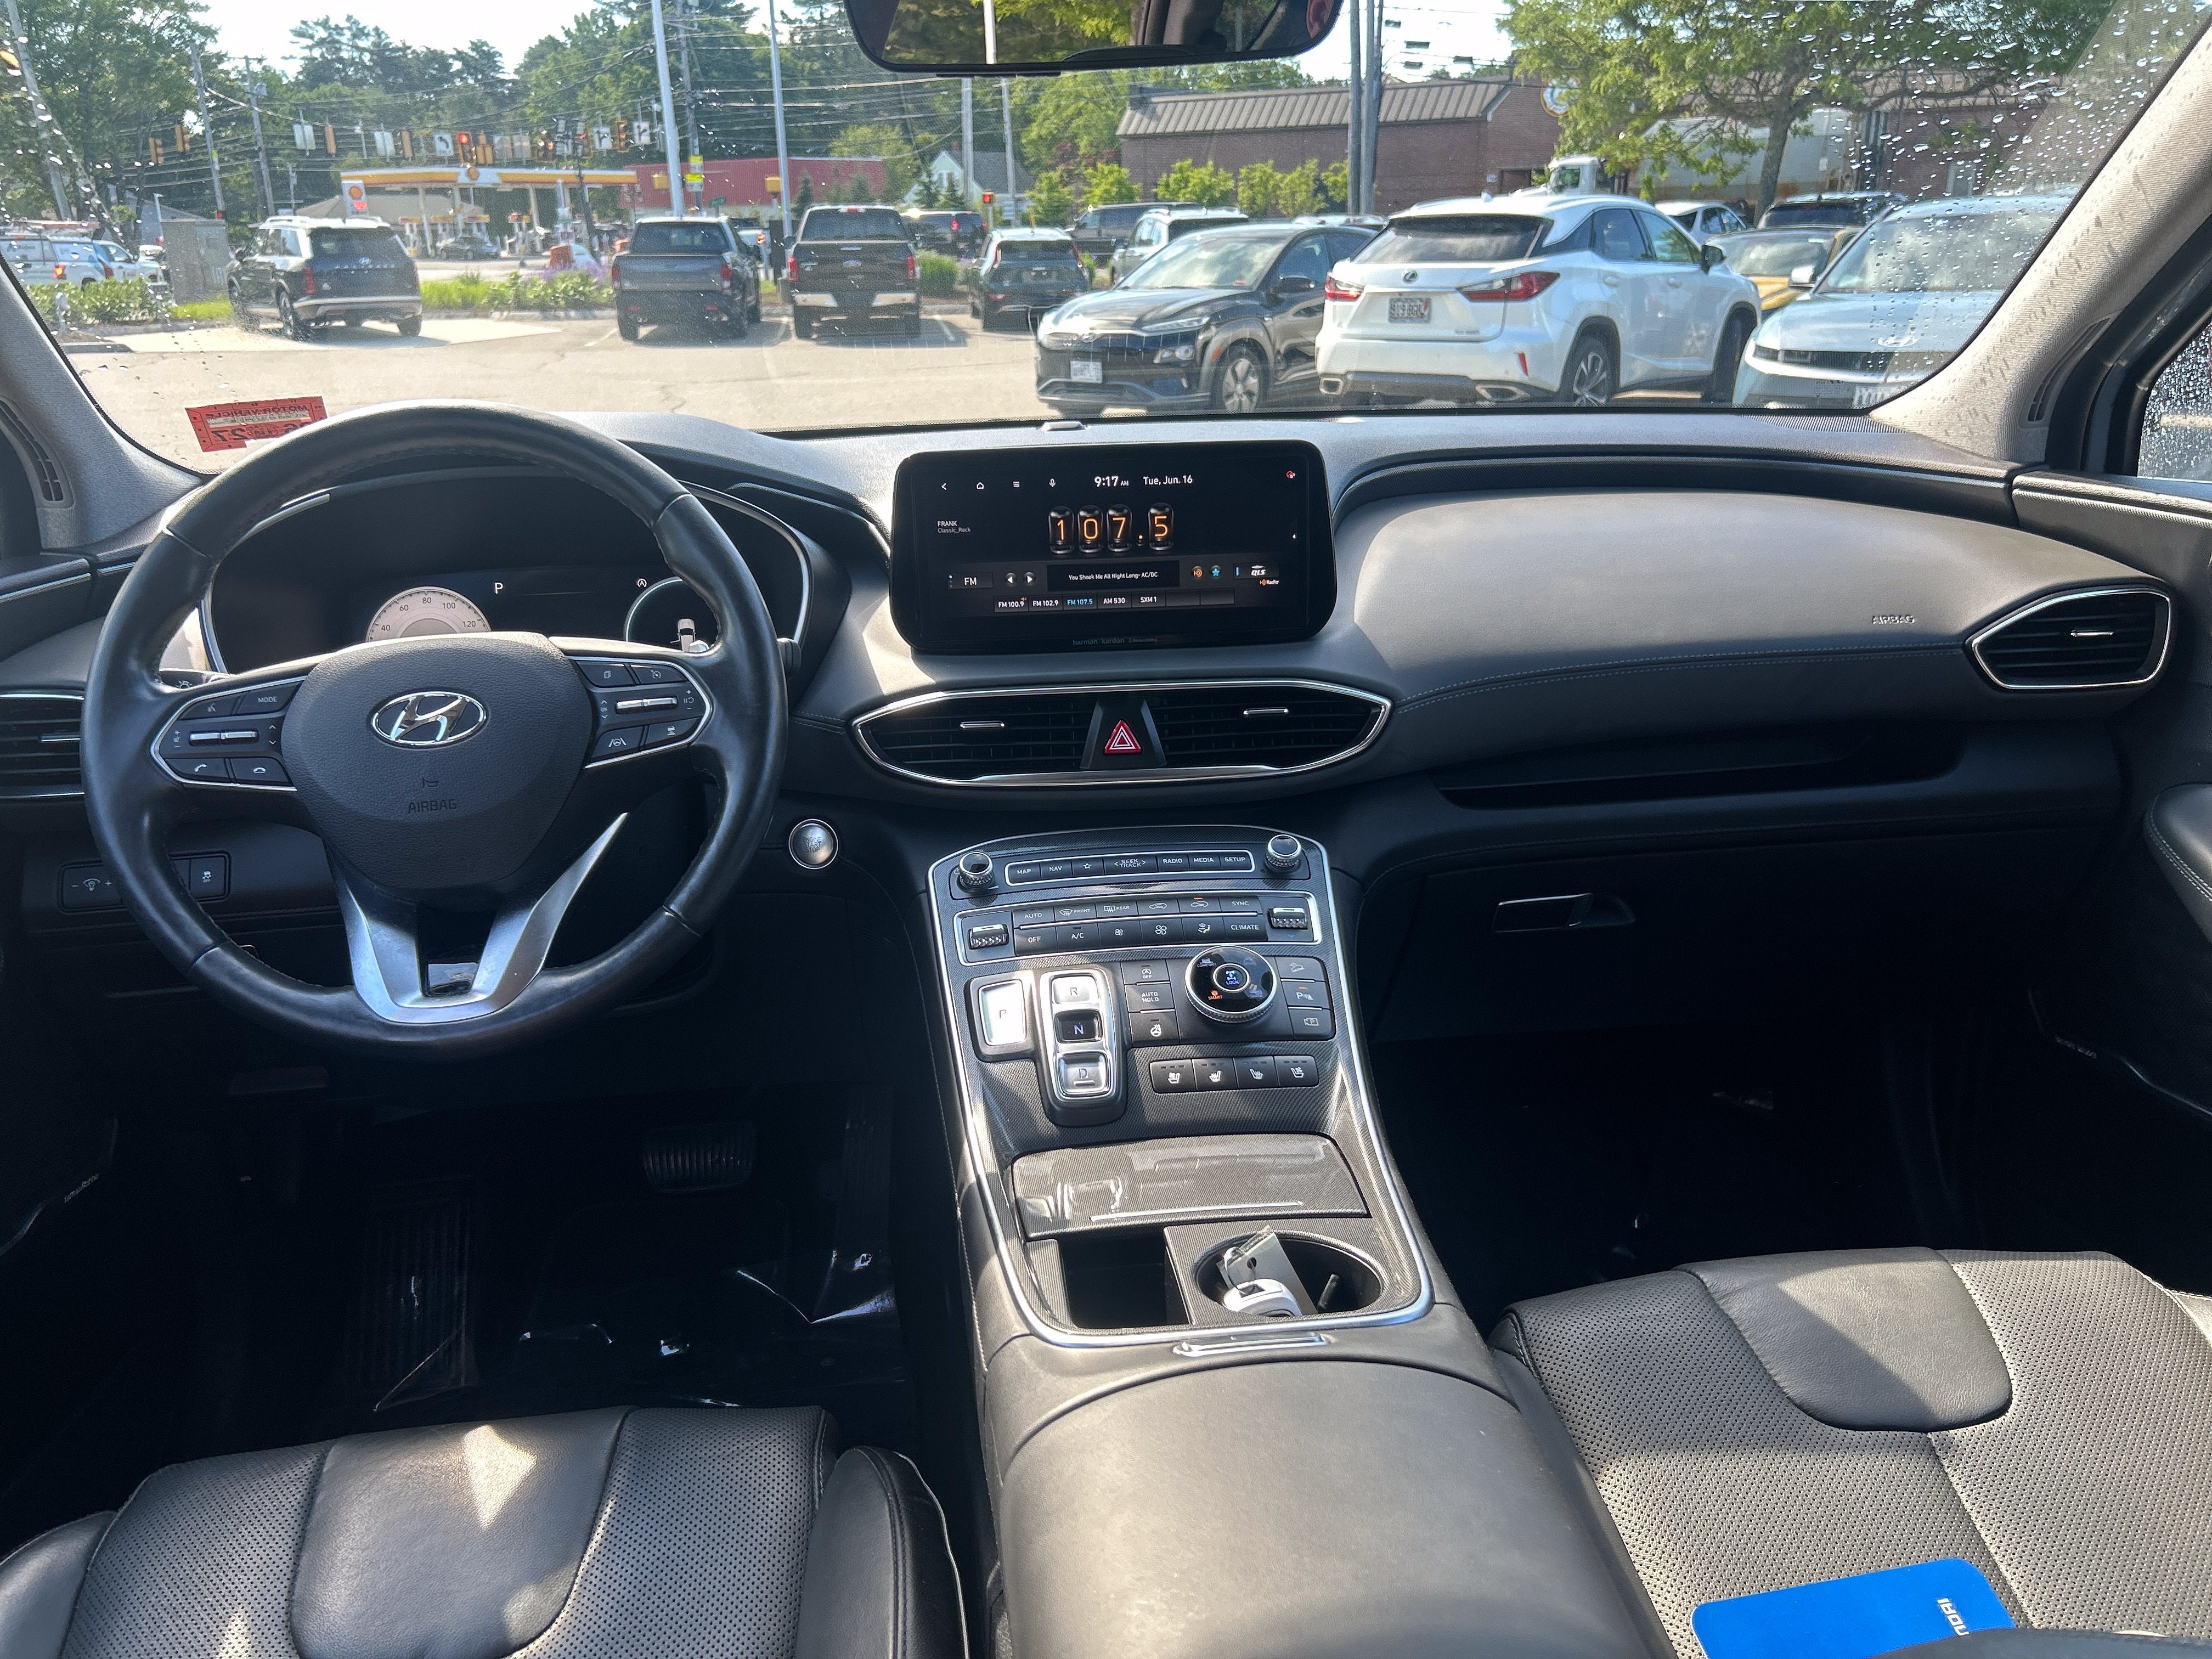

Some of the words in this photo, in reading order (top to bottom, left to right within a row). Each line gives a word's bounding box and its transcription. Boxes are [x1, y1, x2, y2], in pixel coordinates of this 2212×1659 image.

[1094, 476, 1119, 487] 9:17
[1143, 476, 1161, 486] Tue,
[1163, 476, 1181, 485] Jun.
[1183, 475, 1193, 484] 16
[964, 577, 977, 586] FM
[494, 582, 504, 594] P
[408, 798, 457, 814] AIRBAG
[1070, 987, 1078, 996] R
[1073, 1024, 1084, 1035] N
[1079, 1068, 1088, 1079] D
